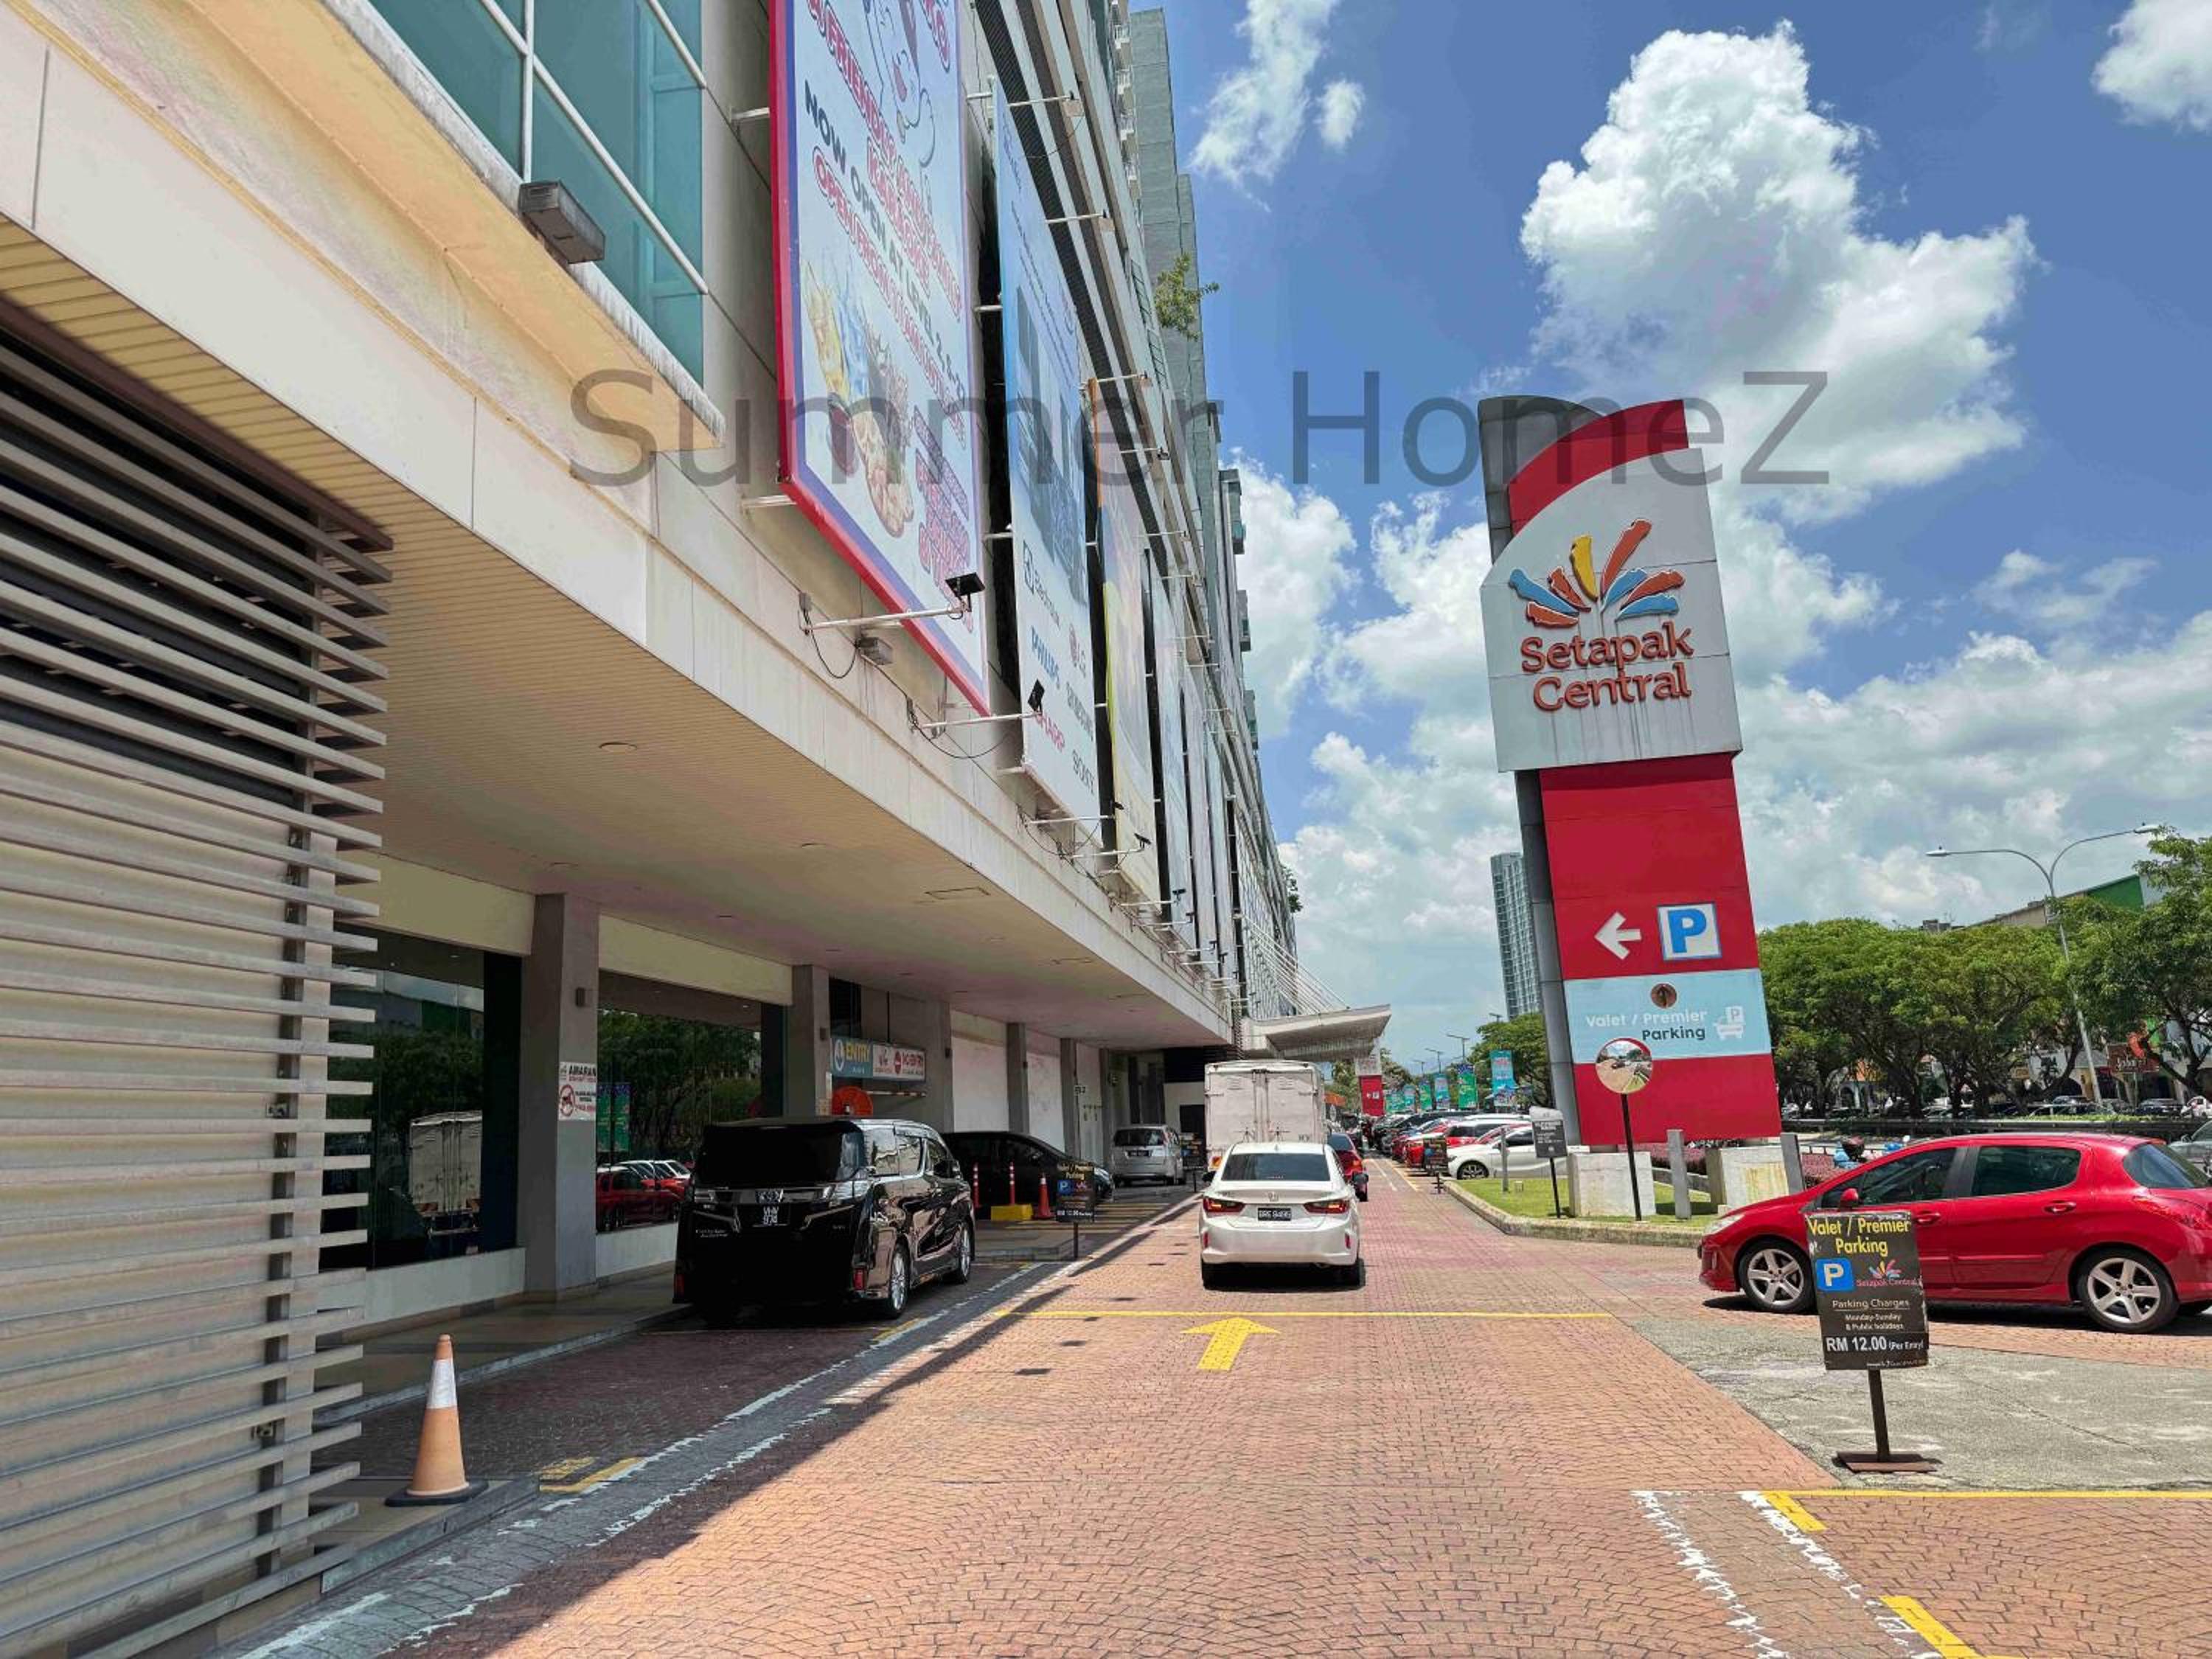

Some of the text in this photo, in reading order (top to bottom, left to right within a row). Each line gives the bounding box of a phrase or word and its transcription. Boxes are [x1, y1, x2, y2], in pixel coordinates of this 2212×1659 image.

[804, 79, 846, 174] NOW
[851, 166, 887, 252] OPEN
[888, 239, 903, 281] AT
[813, 148, 855, 242] OPEN
[1521, 621, 1694, 672] Setapak
[1533, 661, 1692, 712] Central
[1667, 908, 1707, 953] P
[1586, 1015, 1627, 1028] Valet
[1643, 1009, 1708, 1026] Premier
[1642, 1026, 1706, 1041] Parking
[1808, 1217, 1911, 1237] Valet / Premier
[1835, 1237, 1888, 1257] Parking
[1823, 1263, 1844, 1287] P
[1832, 1298, 1910, 1310] Parking Charges
[1826, 1337, 1849, 1352] RM
[1851, 1336, 1887, 1351] 12.00
